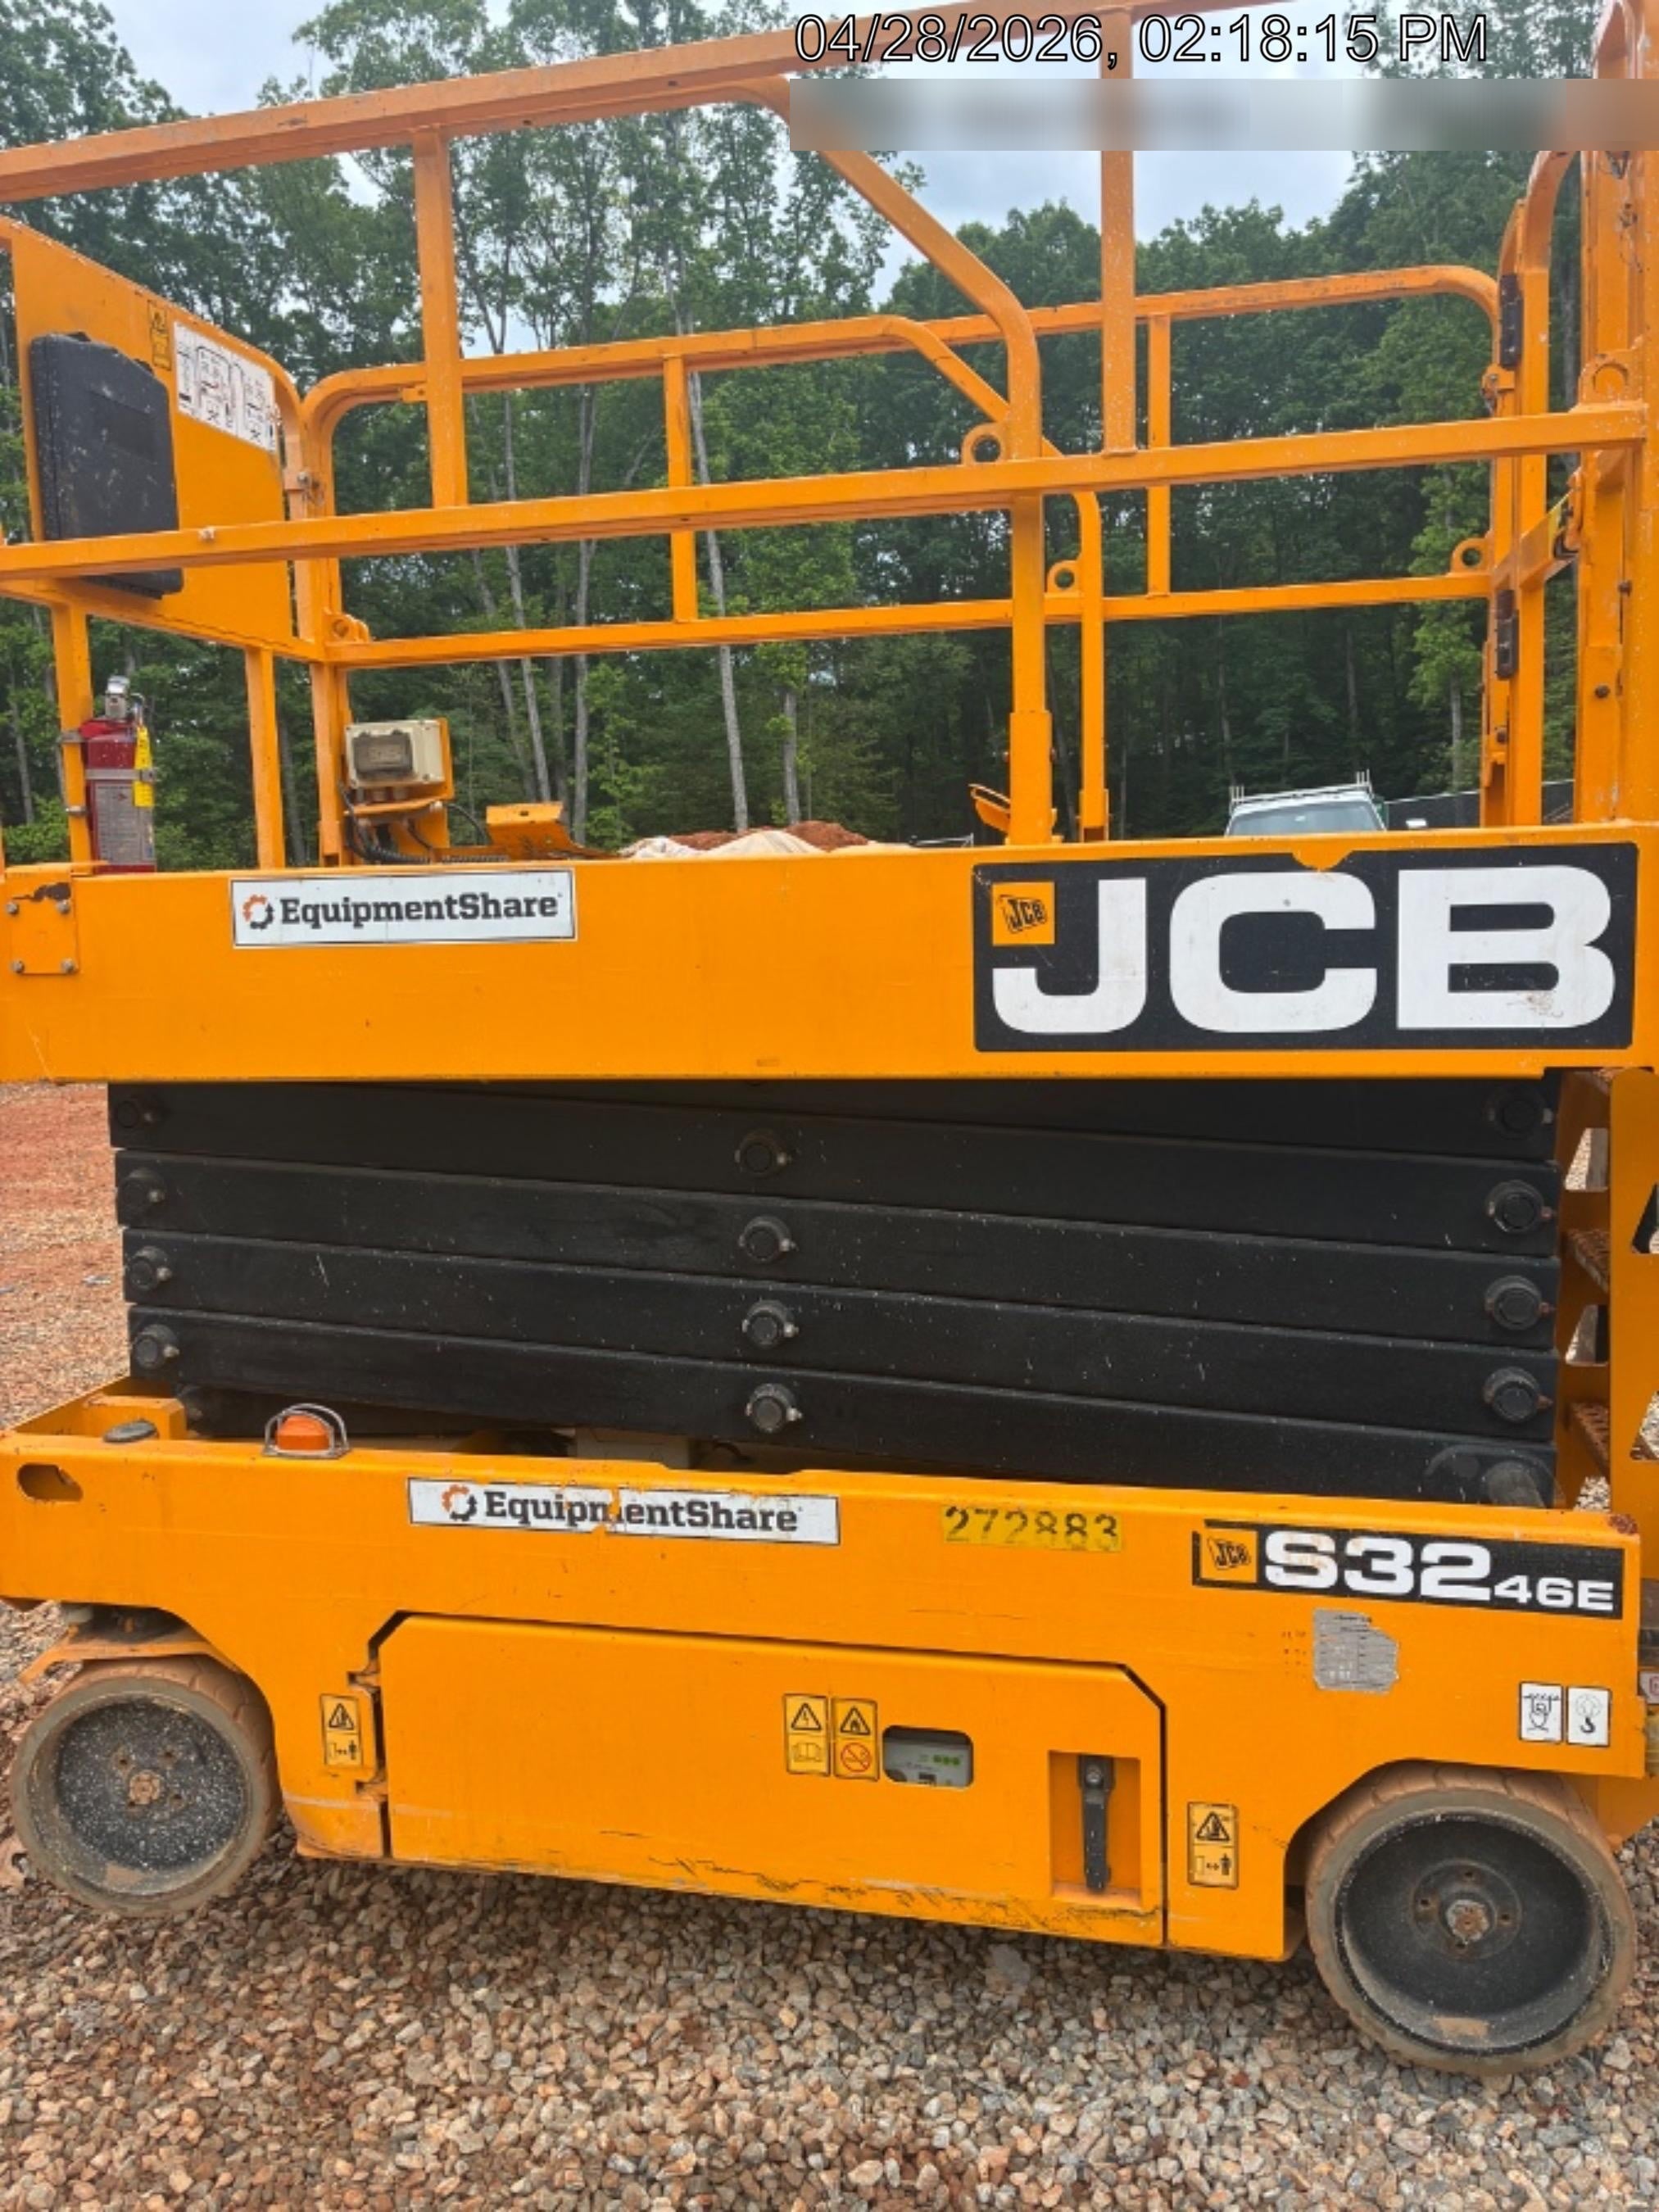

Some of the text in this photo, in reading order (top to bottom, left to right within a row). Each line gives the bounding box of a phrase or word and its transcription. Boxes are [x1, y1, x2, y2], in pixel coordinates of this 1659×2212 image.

[280, 892, 557, 929] EquipmentShare
[1000, 896, 1047, 931] JCB
[992, 864, 1616, 1034] JCB
[945, 1506, 1117, 1551] 272883
